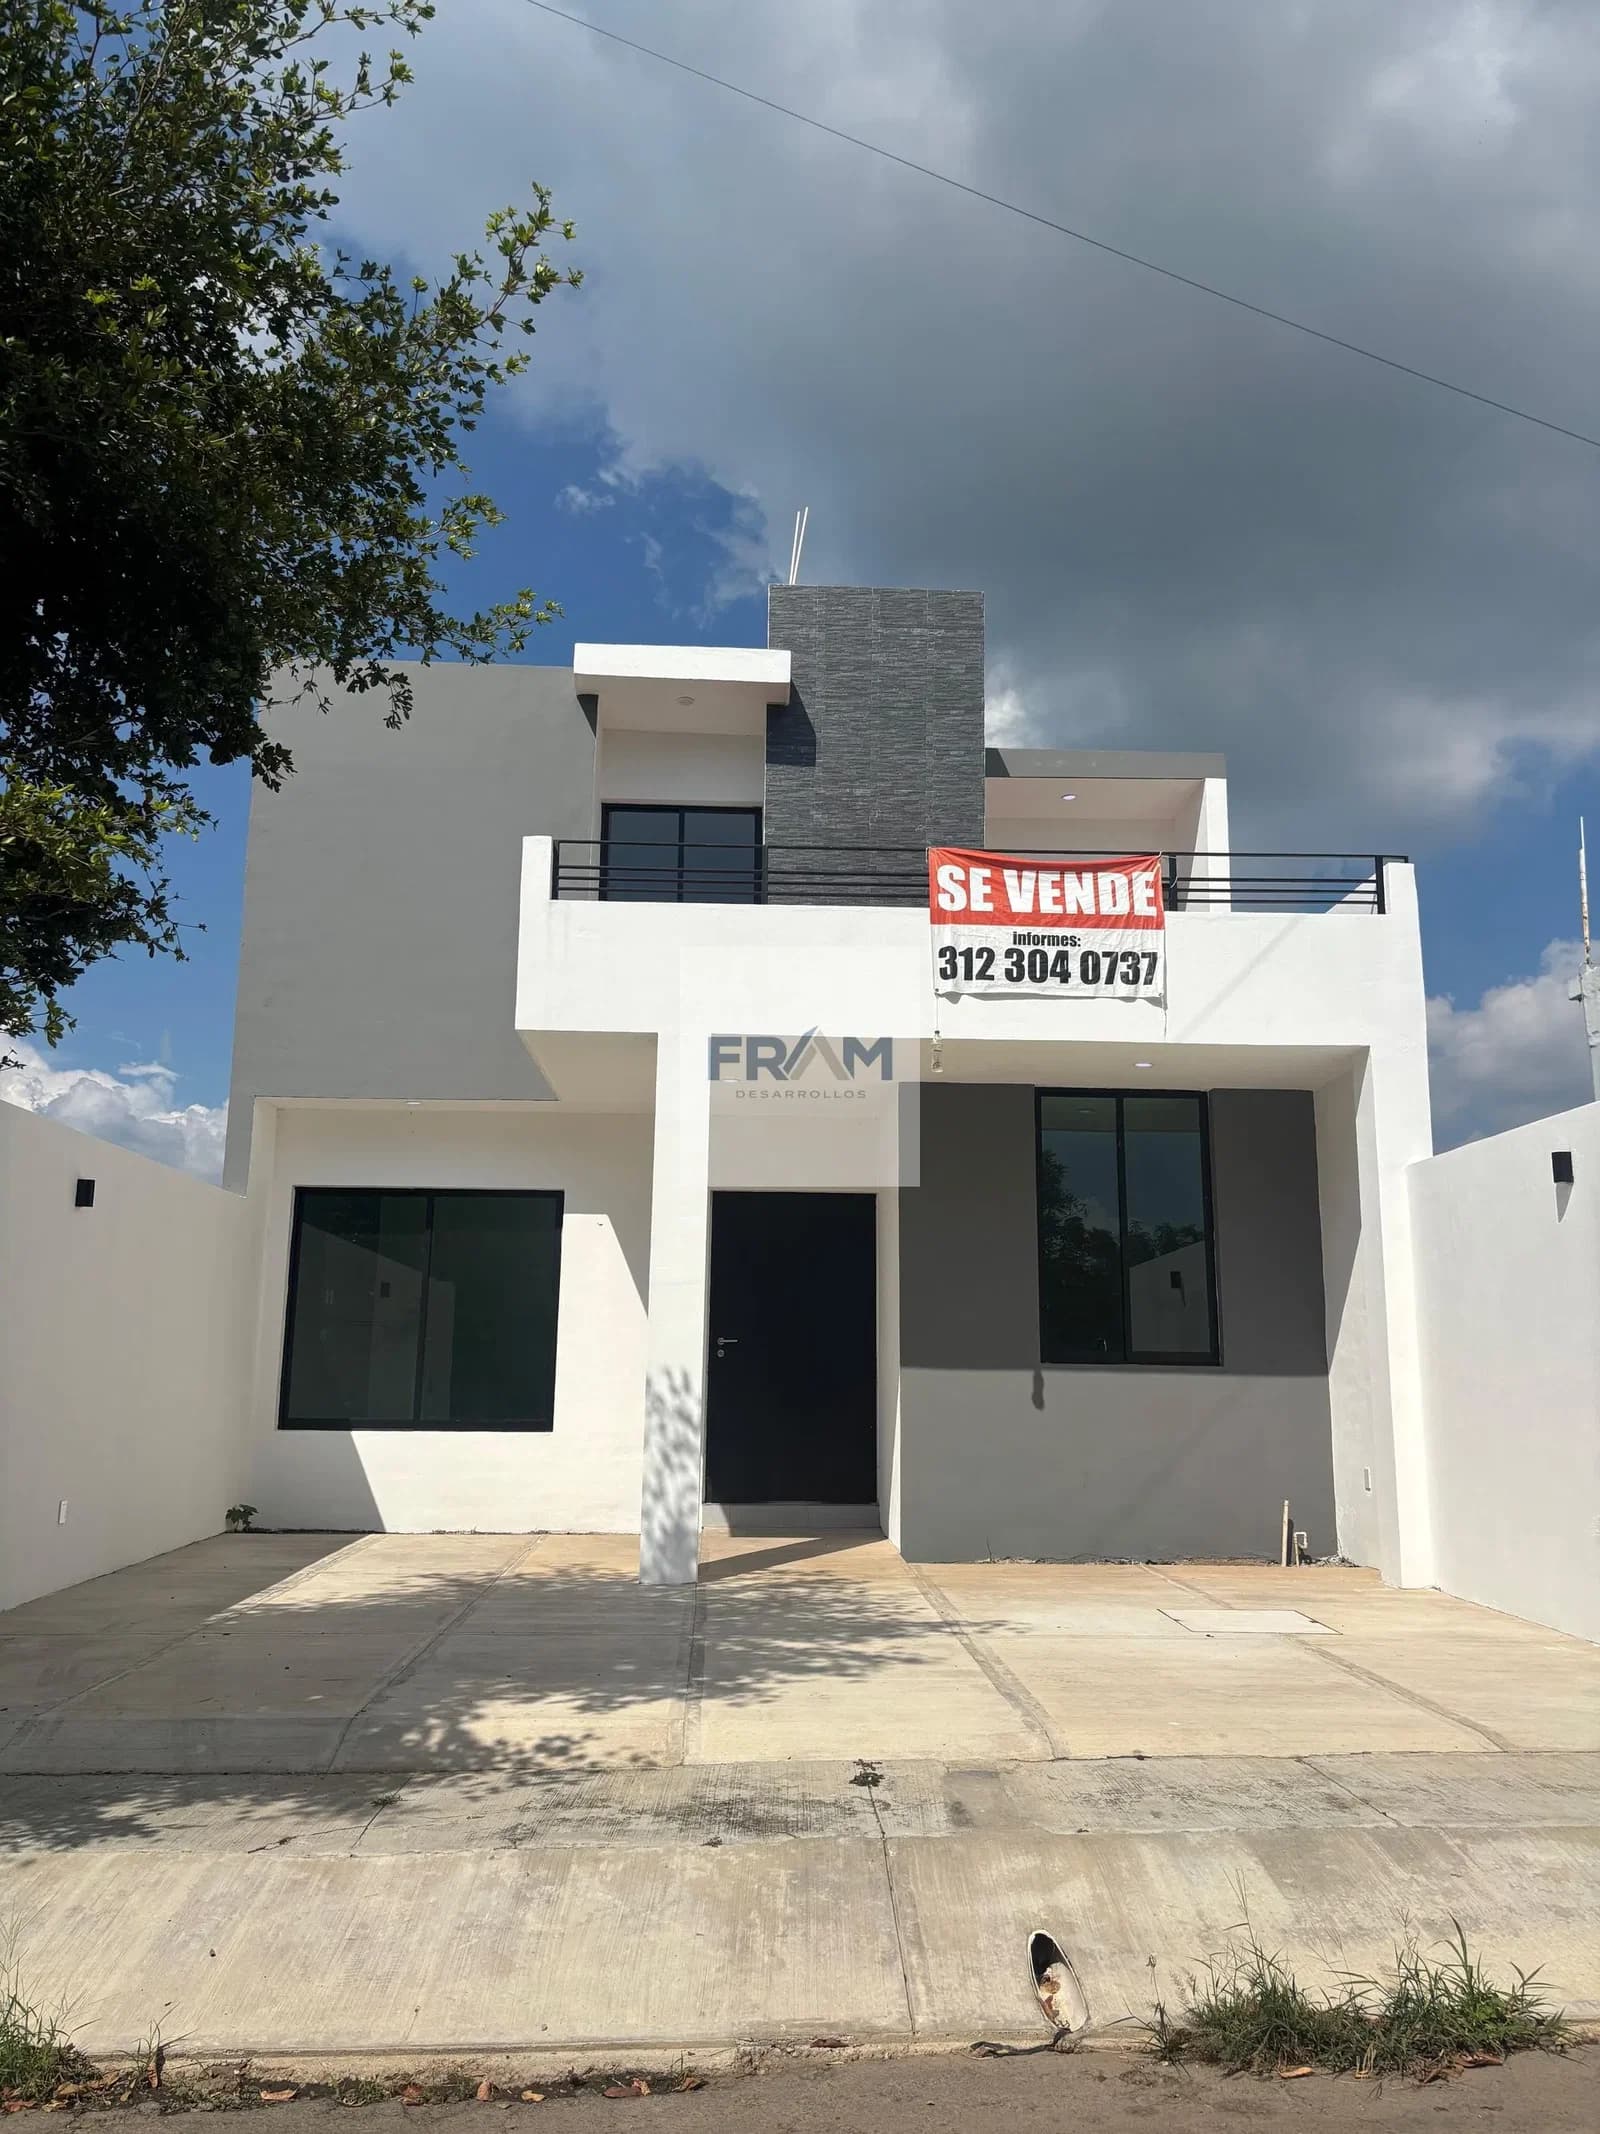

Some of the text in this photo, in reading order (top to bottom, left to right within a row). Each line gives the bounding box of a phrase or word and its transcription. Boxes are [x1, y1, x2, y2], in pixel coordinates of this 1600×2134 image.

[937, 864, 1157, 917] SE VENDE
[1012, 931, 1081, 948] informes:
[938, 945, 1158, 986] 312 304 0737
